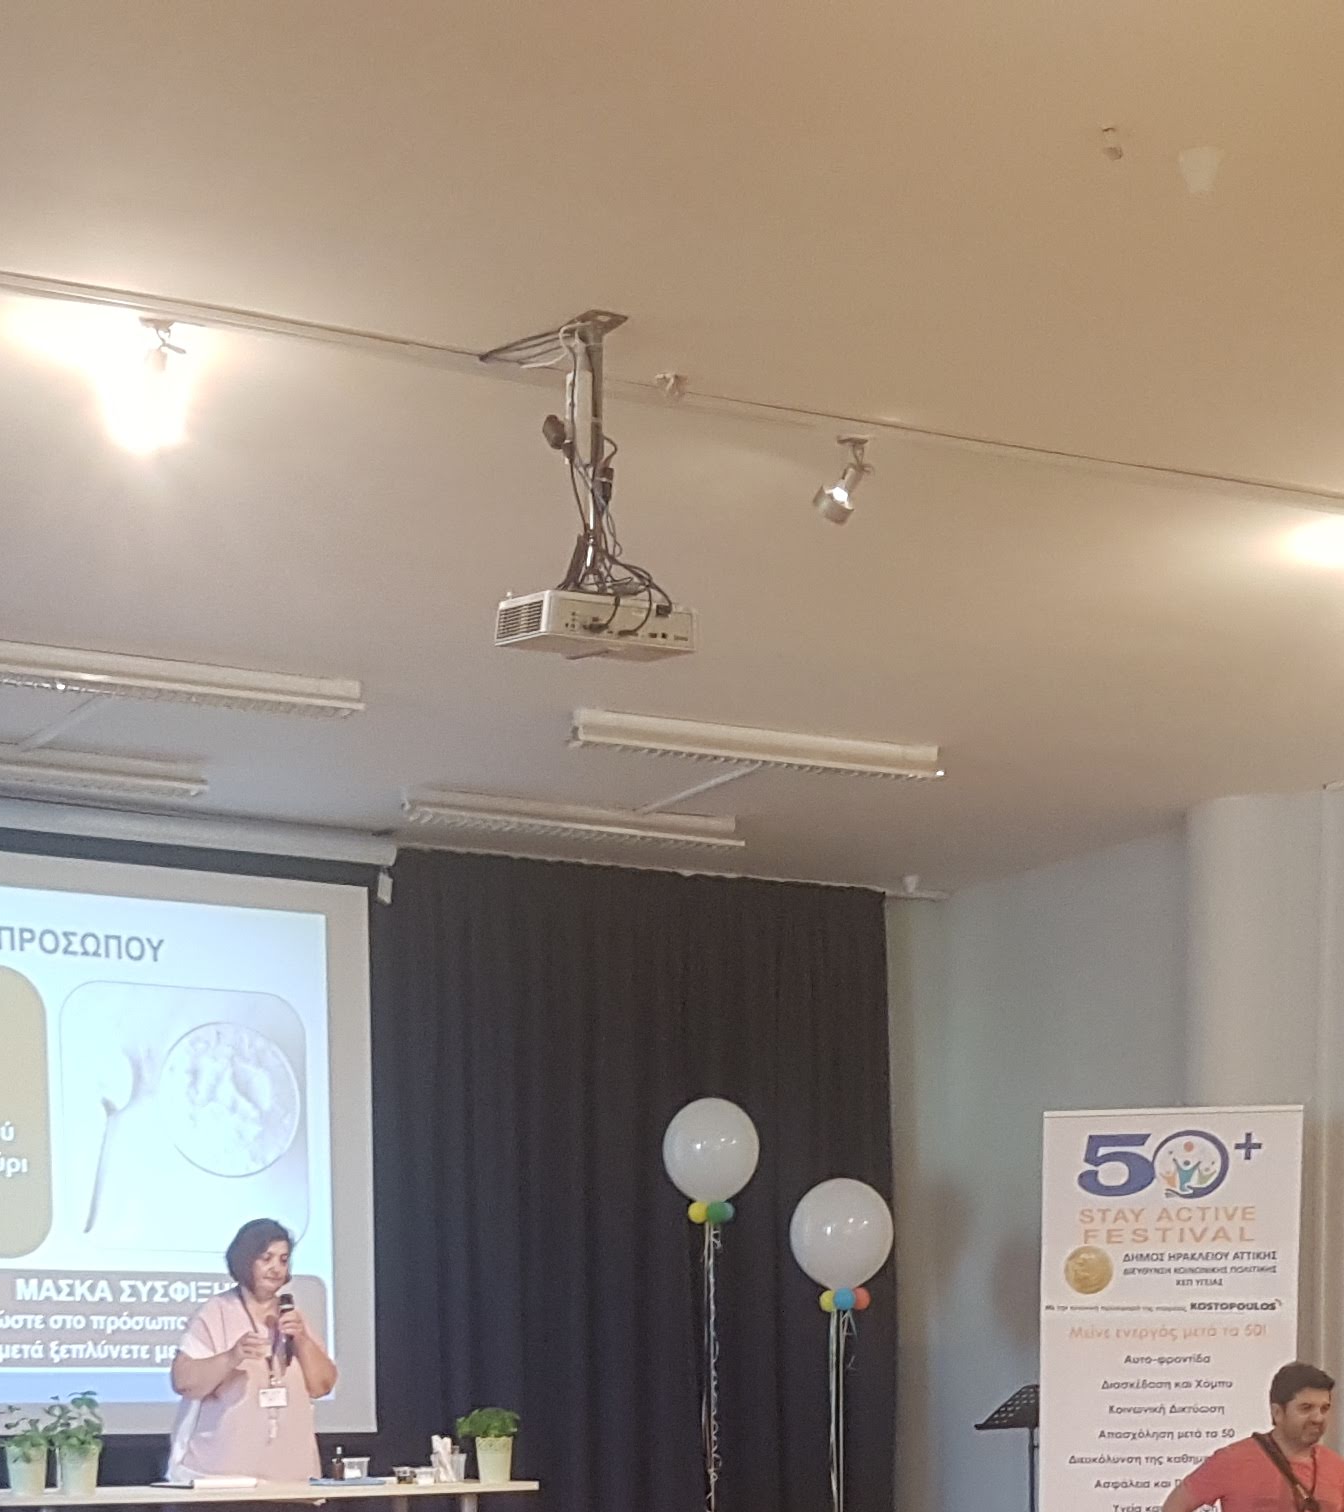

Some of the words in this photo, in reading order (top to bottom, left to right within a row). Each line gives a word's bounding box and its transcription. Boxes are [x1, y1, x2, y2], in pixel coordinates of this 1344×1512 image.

[1078, 1207, 1146, 1225] STAY
[1155, 1205, 1256, 1223] ACTIVE
[1082, 1226, 1256, 1245] FESTIVAL
[1122, 1252, 1165, 1263] ΔΗΜΟΣ
[1167, 1251, 1230, 1262] ΗΡΑΚΛΕΙΟΥ
[1232, 1250, 1277, 1261] ΑΤΤΙΚΗΣ
[15, 1278, 111, 1302] ΜΑΣΚΑ
[1190, 1301, 1277, 1311] KOSTOPOULOS
[49, 1313, 86, 1330] στο
[1069, 1326, 1110, 1339] Μείνε
[1115, 1326, 1178, 1341] ενεργός
[1183, 1325, 1217, 1339] μετά
[1223, 1327, 1239, 1337] τα
[49, 1342, 150, 1364] ξεπλύνετε
[1100, 1378, 1172, 1390] Διασκέδαση
[1173, 1380, 1192, 1389] και
[1108, 1403, 1166, 1416] Κοινωνική
[1168, 1404, 1225, 1415] Δικτύωση
[1098, 1428, 1174, 1442] Απασχόληση
[1177, 1428, 1202, 1440] μετά
[1205, 1430, 1218, 1439] τα
[1221, 1428, 1236, 1439] 50
[1068, 1454, 1142, 1466] Διευκόλυνση
[1144, 1456, 1164, 1466] της
[1094, 1479, 1151, 1489] Ασφάλεια
[1153, 1480, 1172, 1488] και
